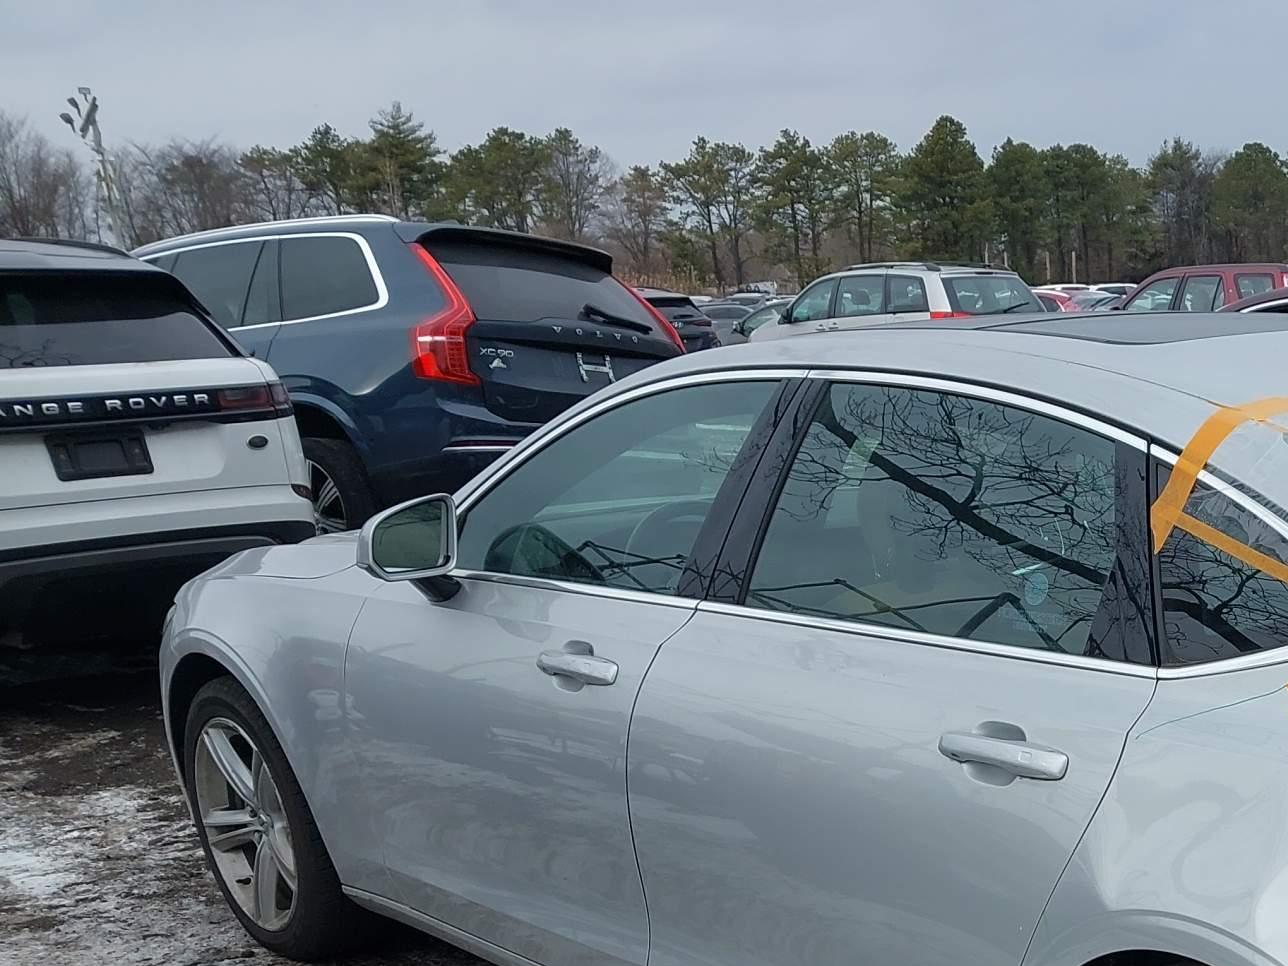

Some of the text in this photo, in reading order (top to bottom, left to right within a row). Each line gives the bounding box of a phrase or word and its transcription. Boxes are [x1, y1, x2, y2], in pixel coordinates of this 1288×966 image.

[552, 325, 639, 344] VOLVO
[480, 347, 514, 358] XC90
[105, 393, 210, 412] ROVER
